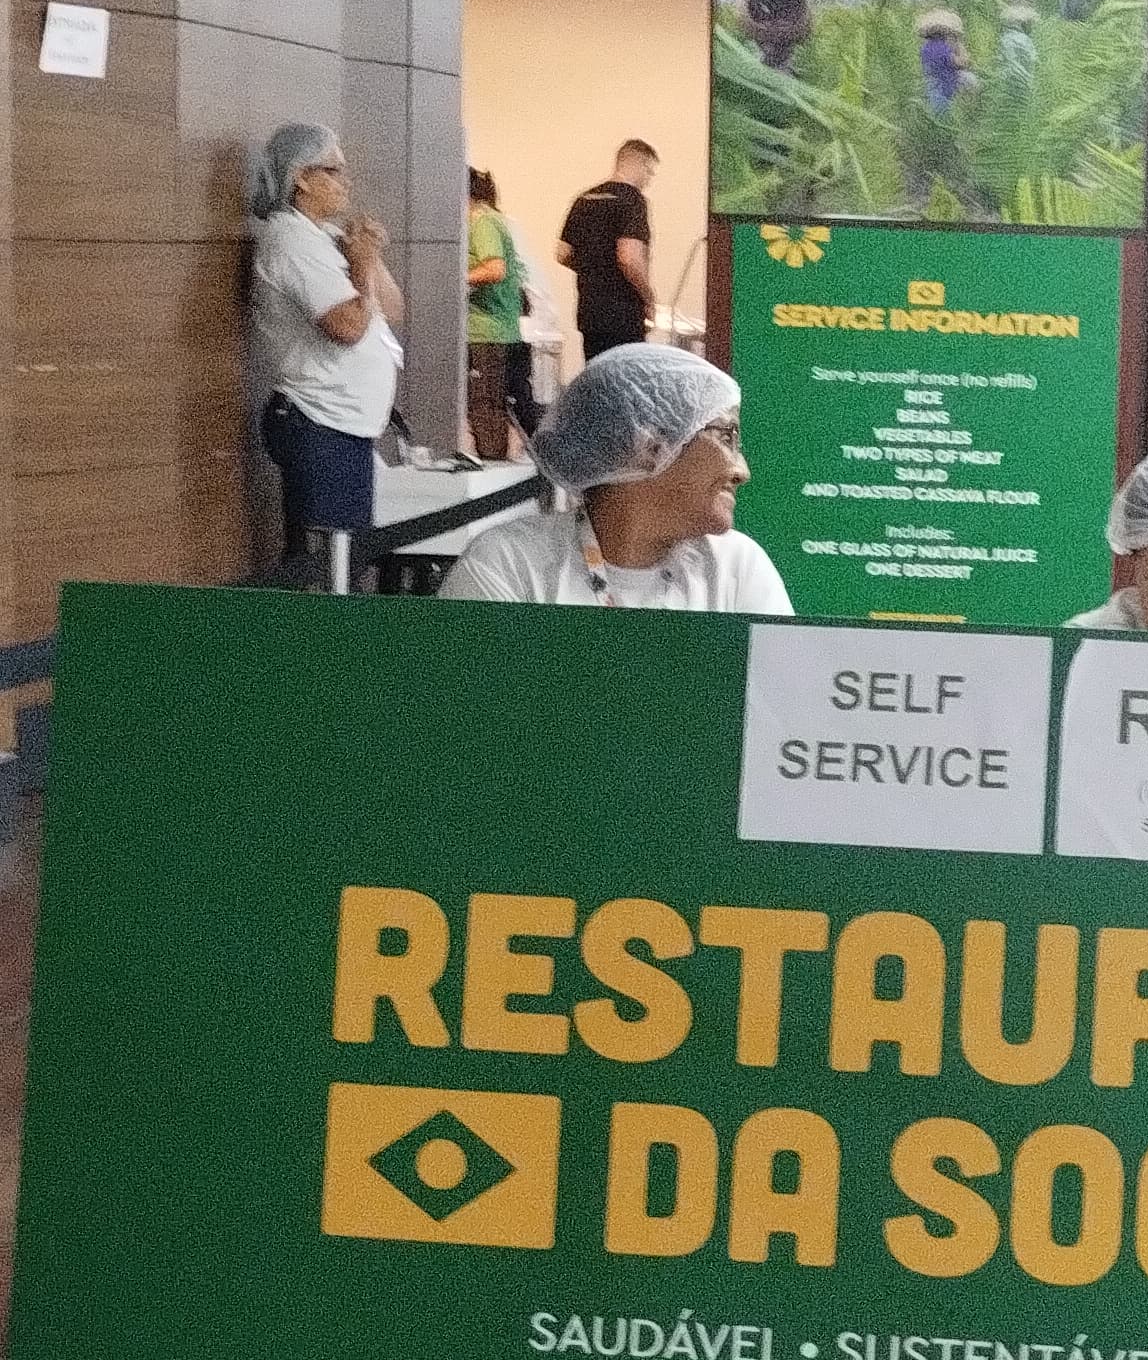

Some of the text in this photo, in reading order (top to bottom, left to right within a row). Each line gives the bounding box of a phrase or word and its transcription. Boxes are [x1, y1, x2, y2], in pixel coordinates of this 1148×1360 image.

[772, 303, 1080, 338] SERVICE INFORMATION
[811, 366, 1038, 390] Serve yourself once (no refills)
[904, 389, 944, 404] RICE
[896, 408, 950, 424] BEANS
[873, 427, 973, 445] VEGETABLES
[840, 445, 1004, 465] TWO TYPES OF MEAT
[895, 467, 949, 482] SALAD
[802, 483, 1040, 505] AND TOASTED CASSAVA FLOUR
[802, 540, 1038, 562] ONE GLASS OF NATURAL JUICE
[865, 561, 974, 579] ONE DESSERT
[829, 669, 966, 716] SELF
[777, 739, 1010, 790] SERVICE
[604, 1100, 841, 1269] DA
